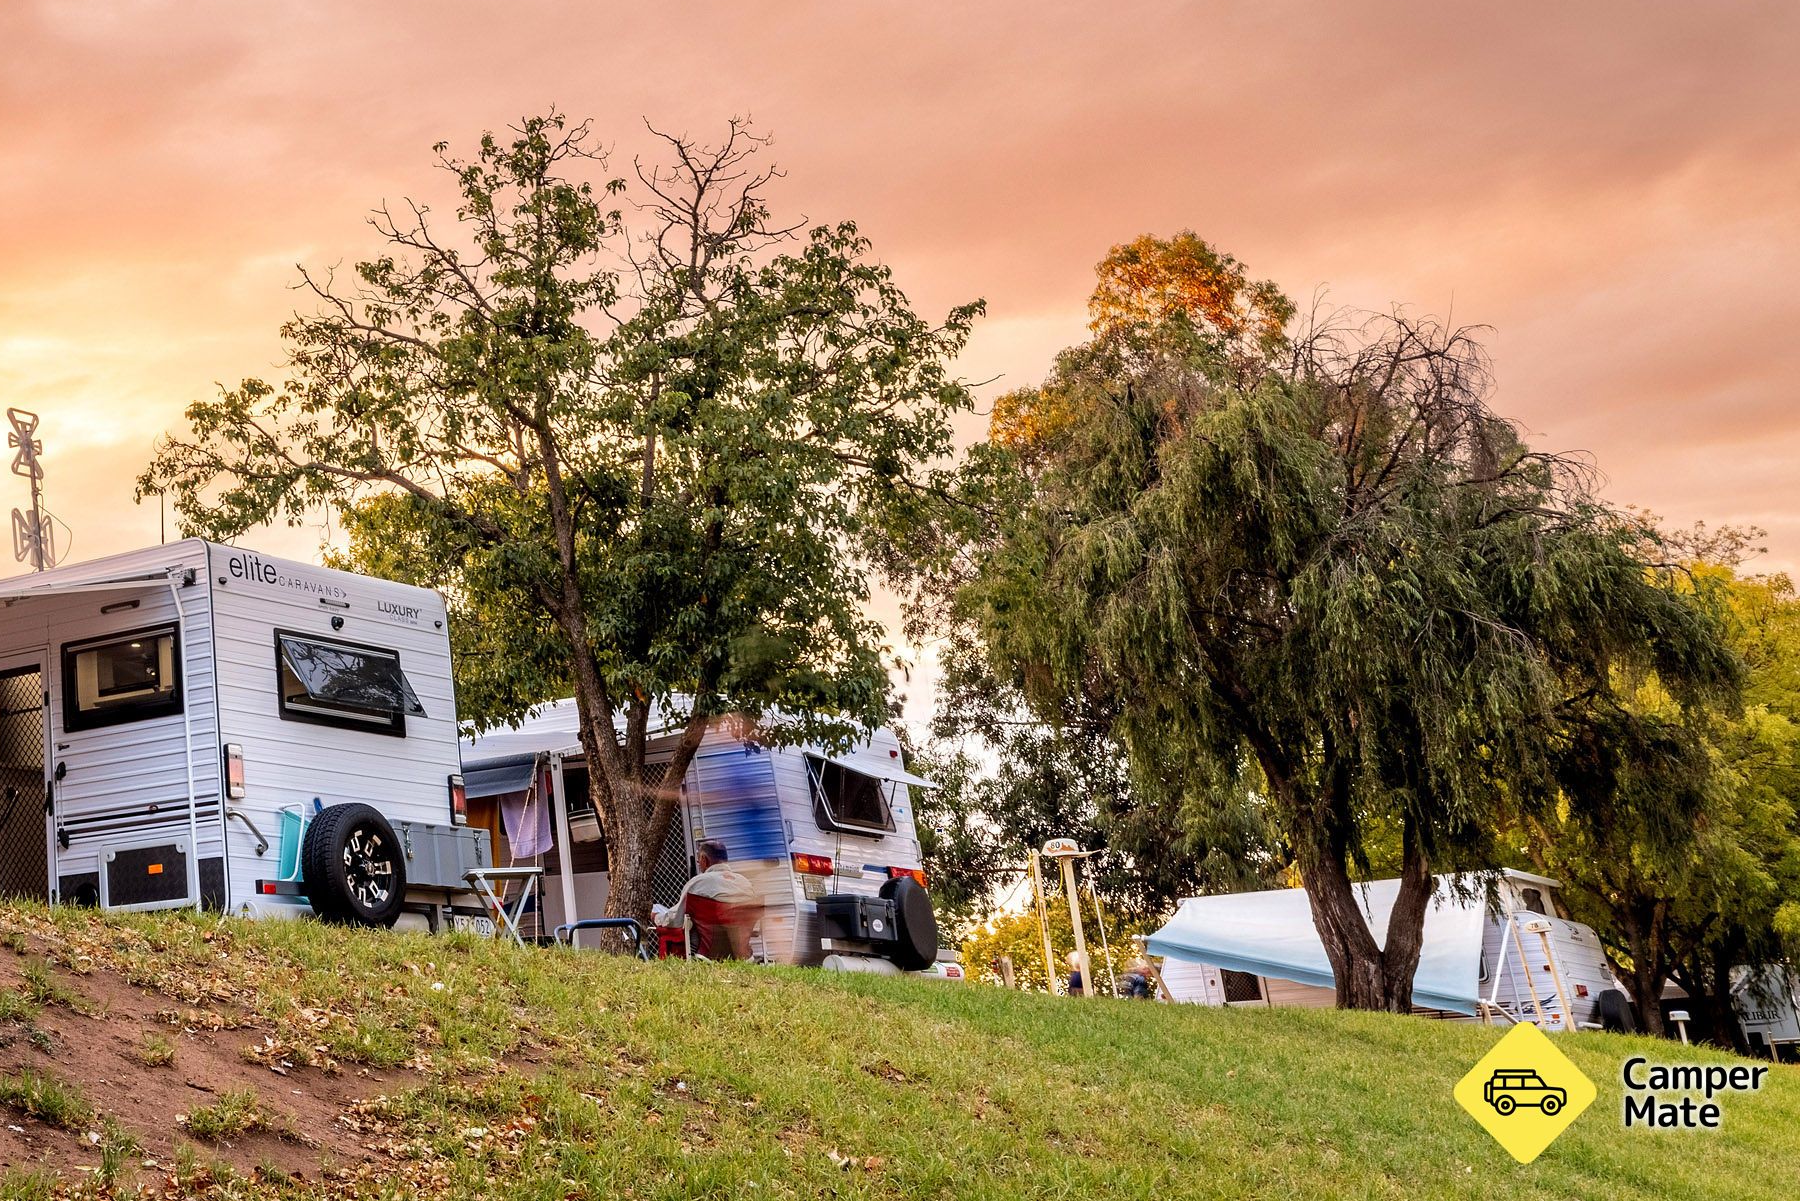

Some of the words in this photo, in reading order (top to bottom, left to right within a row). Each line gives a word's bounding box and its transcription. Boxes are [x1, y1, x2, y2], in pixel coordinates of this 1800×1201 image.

[229, 554, 277, 585] elite
[278, 575, 340, 598] CARAVANS
[377, 600, 419, 619] LUXURY
